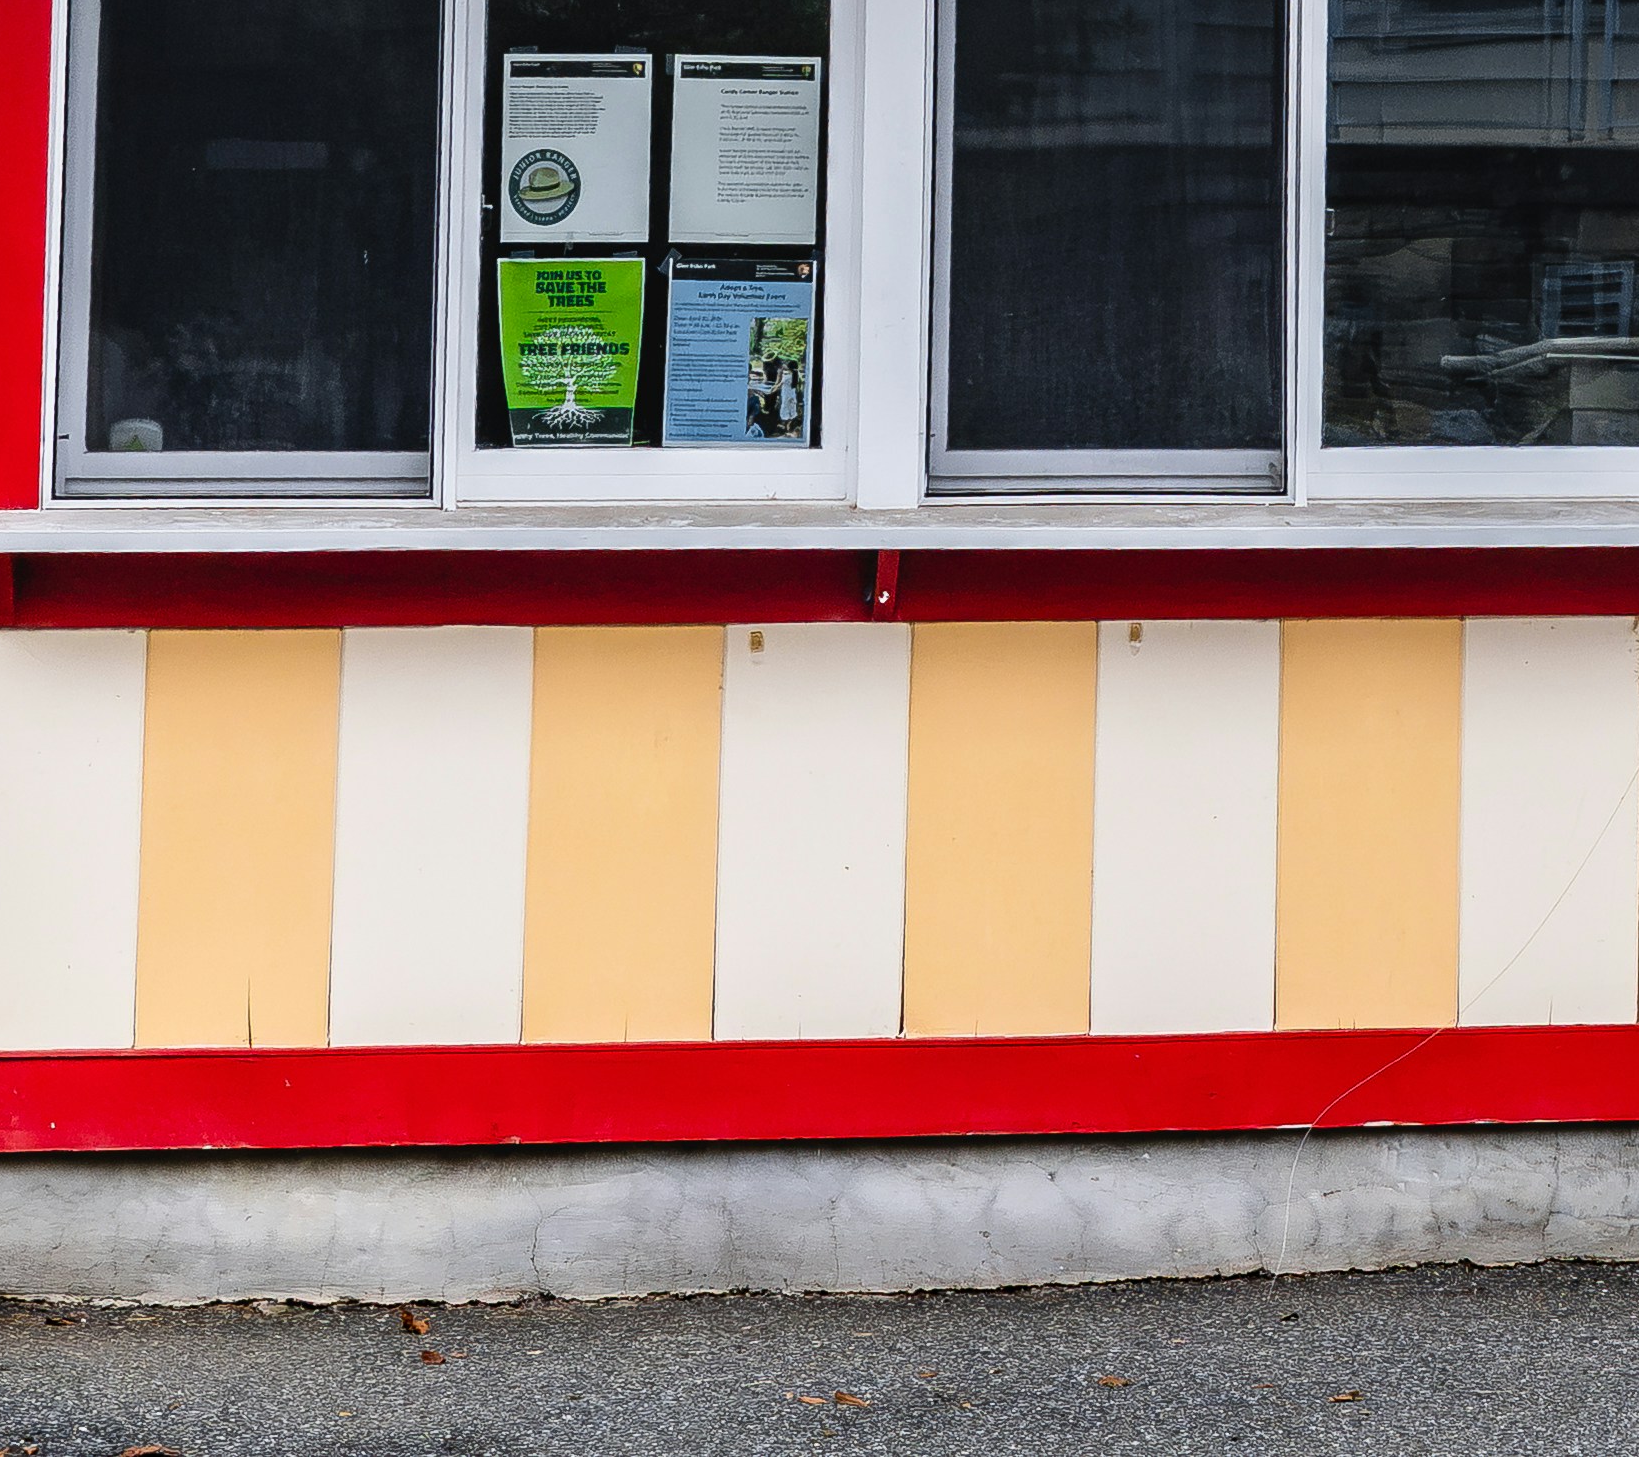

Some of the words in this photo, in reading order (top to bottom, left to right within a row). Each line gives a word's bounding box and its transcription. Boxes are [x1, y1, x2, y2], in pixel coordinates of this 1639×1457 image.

[513, 152, 542, 180] JUNIOR
[545, 151, 579, 180] RANGER
[536, 270, 564, 281] JOIN
[565, 270, 583, 281] US
[584, 270, 602, 281] TO
[535, 281, 576, 294] SAVE
[577, 281, 607, 294] THE
[548, 295, 595, 308] TREES
[518, 342, 558, 356] TREE
[561, 342, 630, 356] FRIENDS
